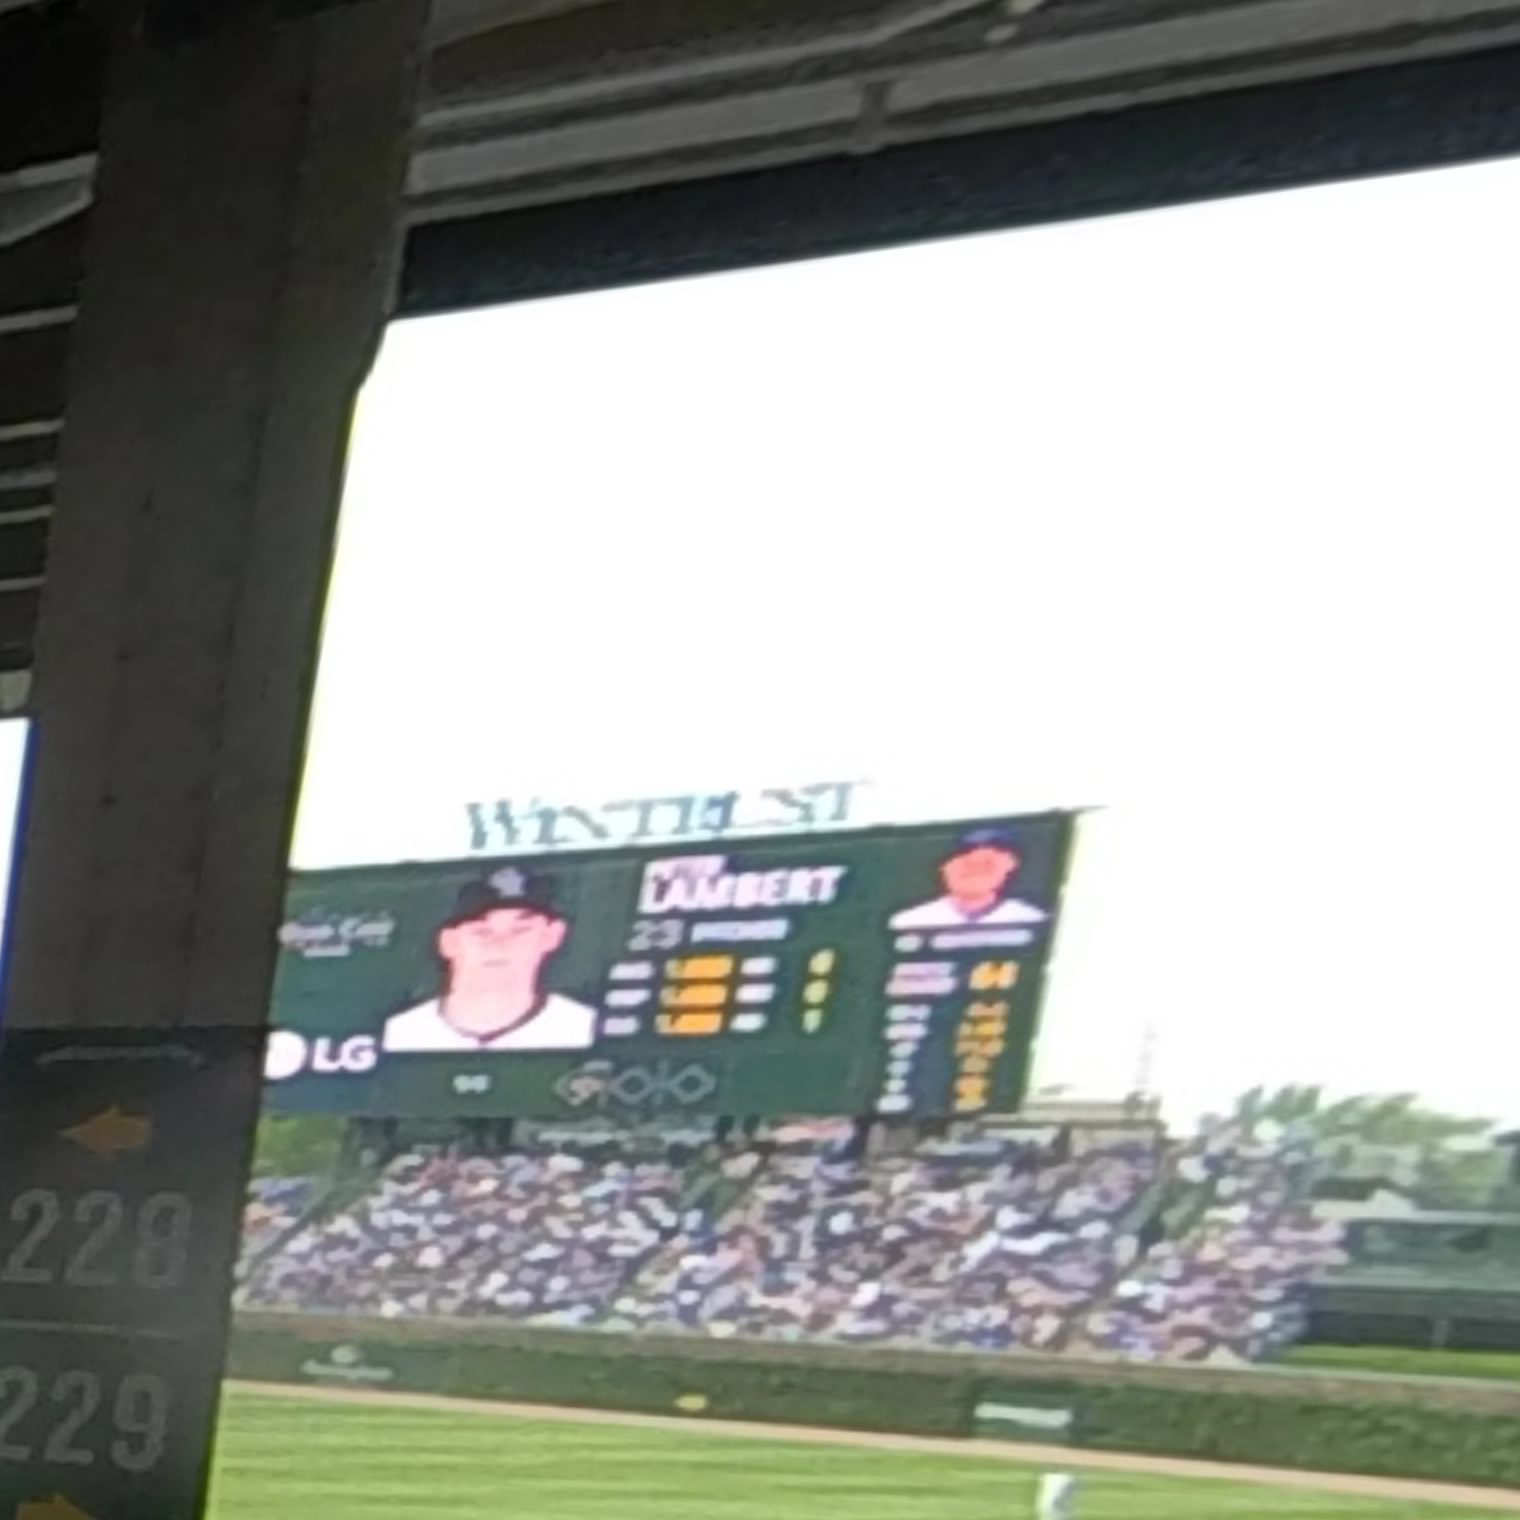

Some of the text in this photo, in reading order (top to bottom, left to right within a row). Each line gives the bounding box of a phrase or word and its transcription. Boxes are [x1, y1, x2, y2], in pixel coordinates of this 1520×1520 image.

[638, 866, 848, 914] LAMBERT
[311, 1034, 378, 1074] LG
[2, 1188, 194, 1288] 228
